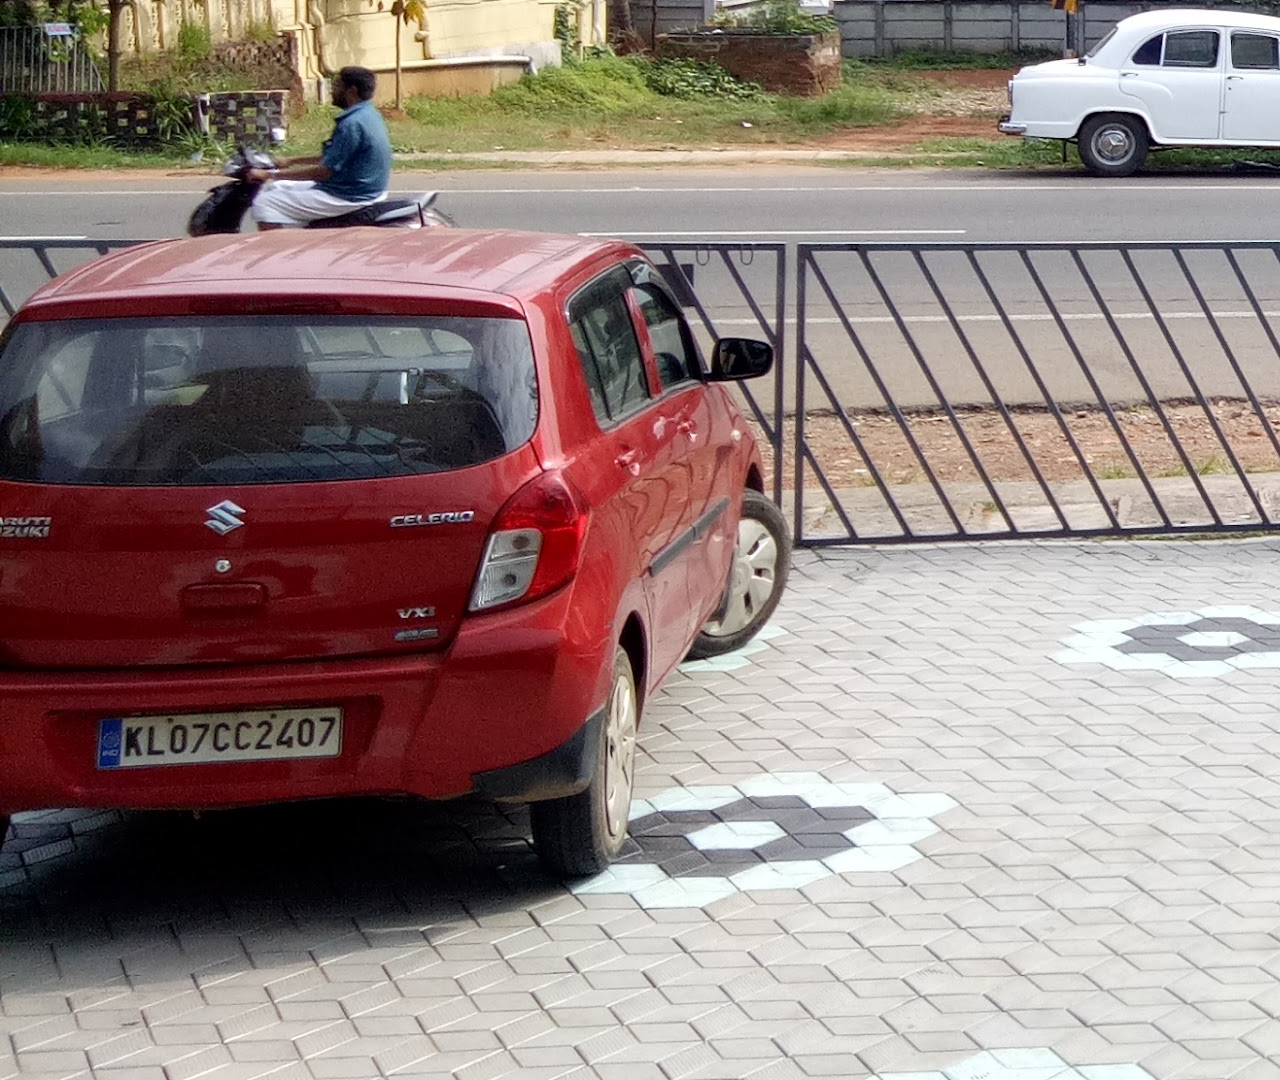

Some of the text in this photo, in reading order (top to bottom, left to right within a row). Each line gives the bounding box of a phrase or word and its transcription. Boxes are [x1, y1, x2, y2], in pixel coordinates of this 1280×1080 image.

[0, 516, 52, 526] RUTI
[390, 511, 475, 527] CELERIO
[0, 526, 50, 538] ZUKI
[124, 717, 337, 758] KL07CC2407
